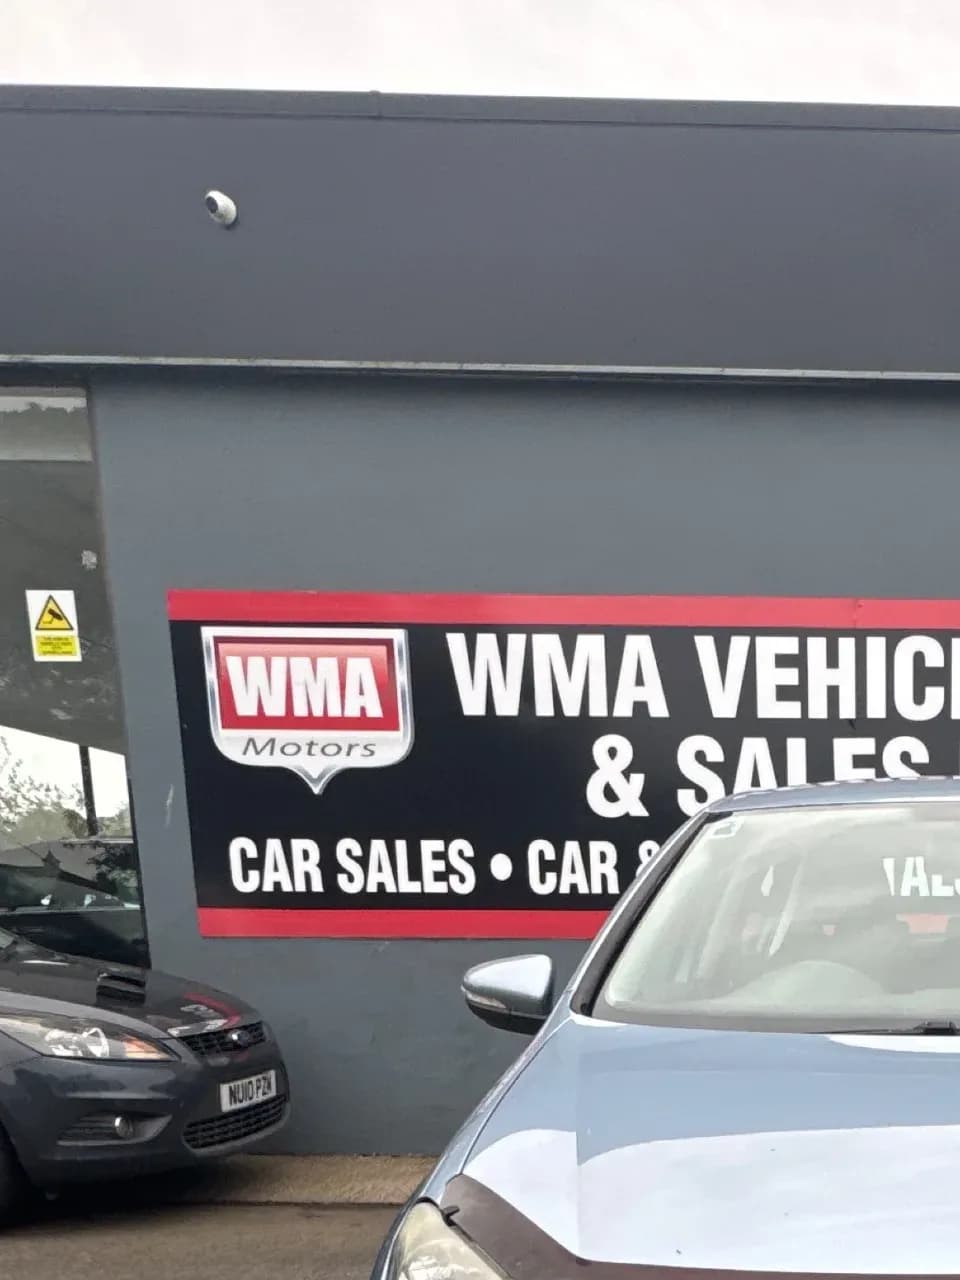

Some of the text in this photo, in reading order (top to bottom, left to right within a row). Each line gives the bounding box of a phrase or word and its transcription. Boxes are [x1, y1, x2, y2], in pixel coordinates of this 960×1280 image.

[225, 654, 383, 718] WMA
[445, 632, 670, 718] WMA
[241, 736, 377, 758] Motors
[586, 734, 650, 818] &
[229, 836, 324, 894] CAR
[335, 837, 476, 895] SALES
[526, 839, 621, 895] CAR
